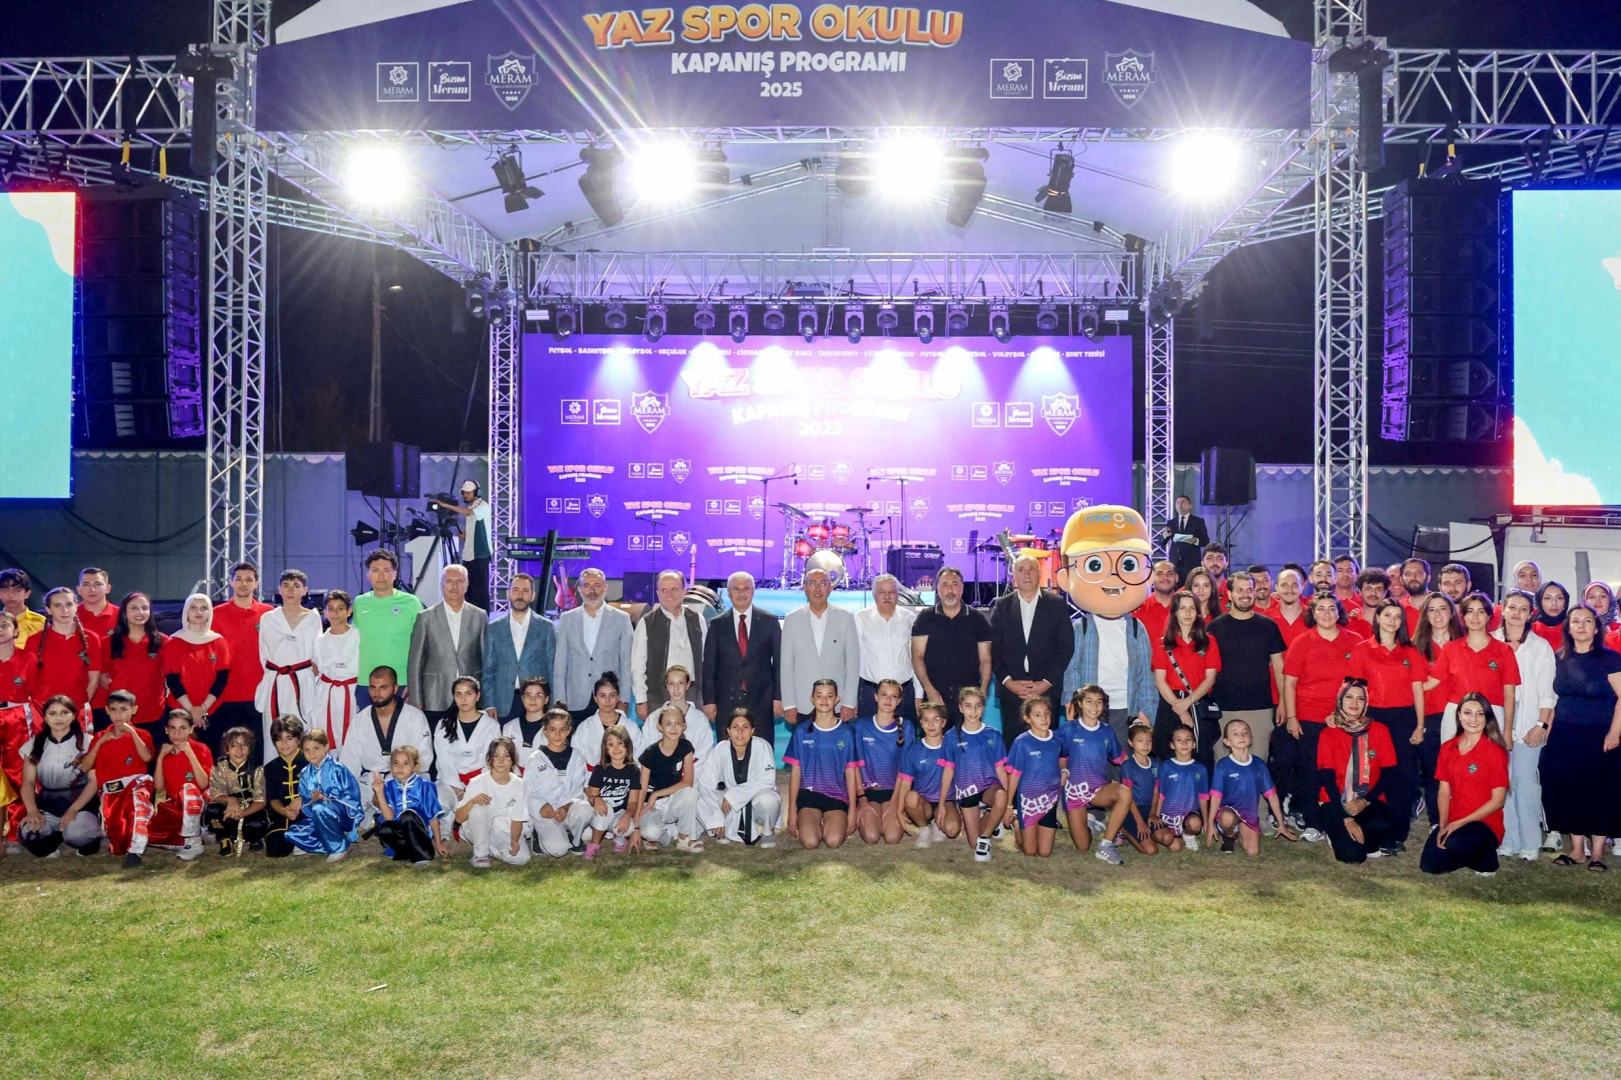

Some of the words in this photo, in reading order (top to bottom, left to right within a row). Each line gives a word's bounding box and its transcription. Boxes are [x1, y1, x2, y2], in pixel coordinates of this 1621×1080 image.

[582, 8, 675, 49] YAZ
[682, 4, 802, 43] SPOR
[810, 4, 964, 48] OKULU
[671, 51, 775, 78] KAPANIŞ
[780, 51, 907, 73] PROGRAMI
[489, 74, 532, 84] MERAM
[1107, 72, 1150, 81] MERAM
[383, 87, 414, 95] MERAM
[432, 84, 468, 94] Meram
[760, 82, 803, 97] 2025
[997, 84, 1028, 92] MERAM
[1047, 82, 1084, 91] Meram
[1044, 409, 1075, 417] MERAM
[1084, 512, 1136, 529] mega
